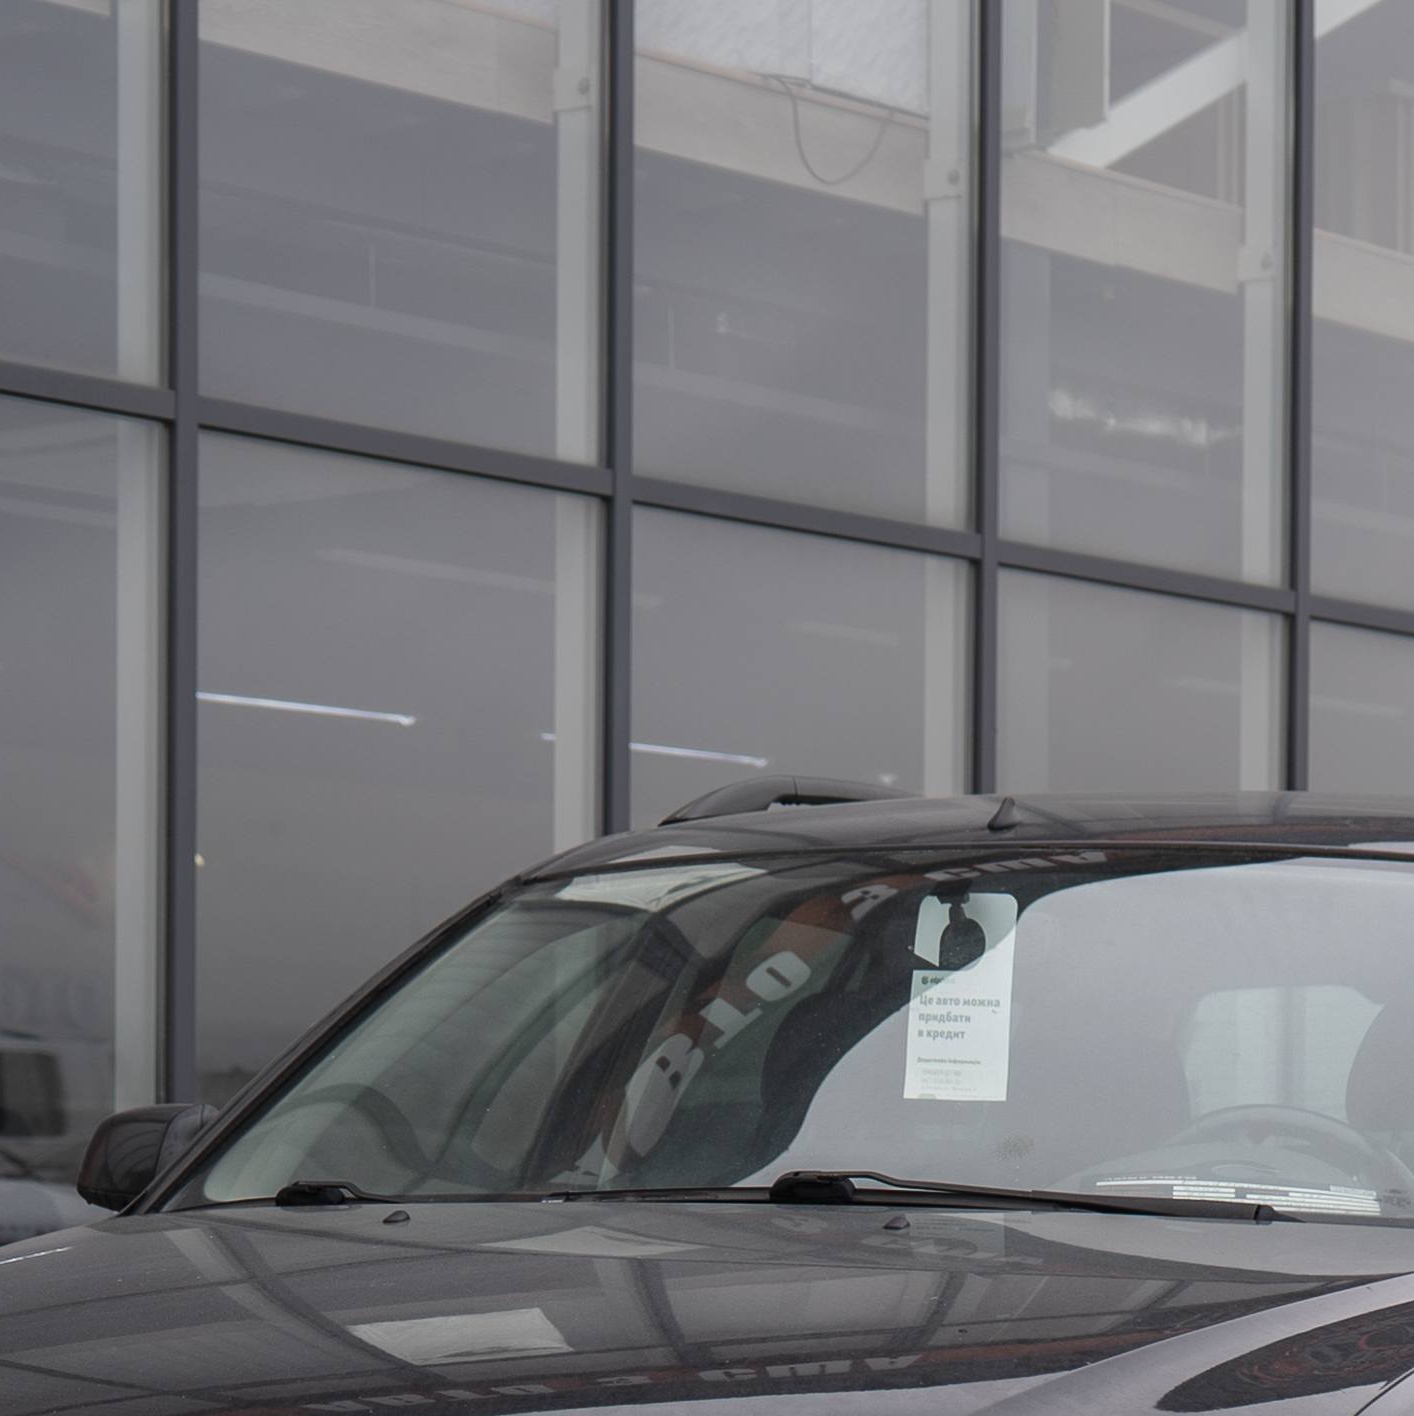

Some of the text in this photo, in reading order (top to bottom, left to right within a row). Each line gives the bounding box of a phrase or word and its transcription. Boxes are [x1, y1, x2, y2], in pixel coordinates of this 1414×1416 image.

[919, 994, 1001, 1008] Це авто можна
[918, 1011, 972, 1024] придбати
[917, 1029, 966, 1040] в кредит
